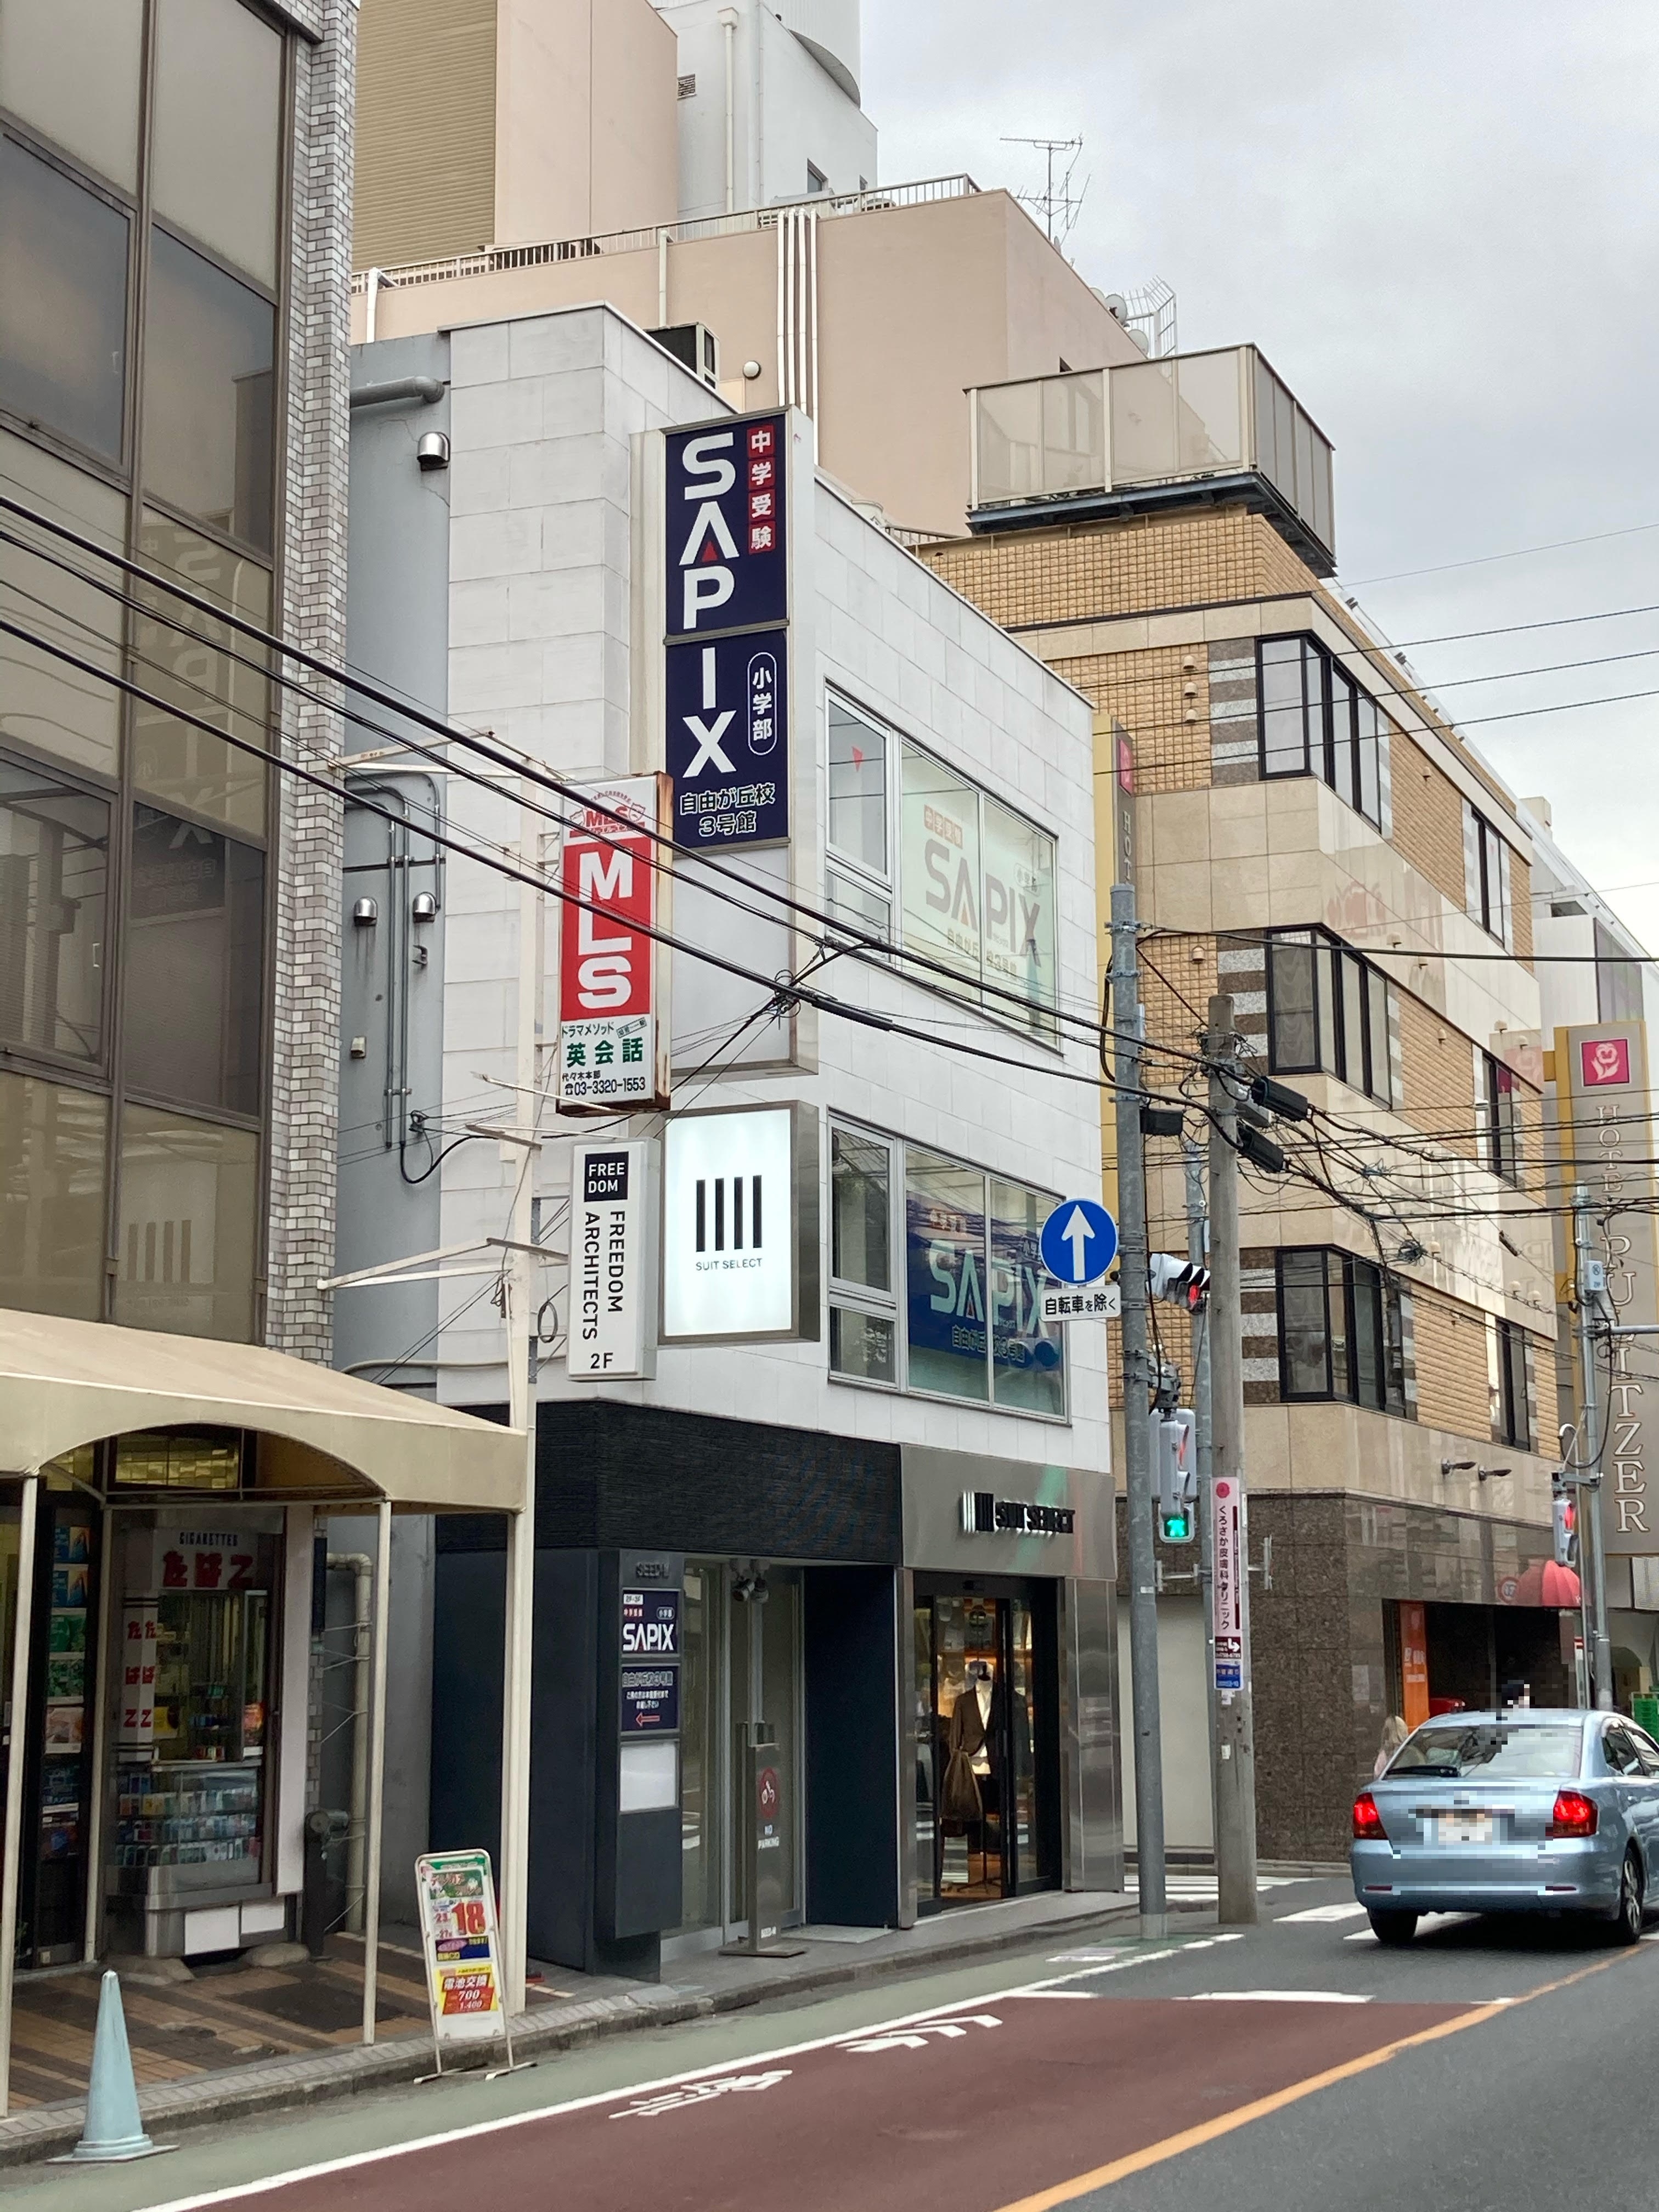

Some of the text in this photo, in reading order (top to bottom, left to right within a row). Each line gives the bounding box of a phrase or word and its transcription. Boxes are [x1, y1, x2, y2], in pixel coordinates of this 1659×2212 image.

[749, 429, 772, 550] 中学受験
[679, 431, 740, 778] SAPIX
[752, 667, 773, 741] 小学部
[680, 783, 776, 815] 自由が丘校
[699, 811, 757, 837] 3号館
[925, 838, 1041, 968] SAPIX
[578, 850, 634, 1009] MLS
[562, 1022, 614, 1039] ドラマメソッド
[567, 1037, 644, 1068] 英会話
[562, 1070, 601, 1082] 代々木本部
[574, 1077, 646, 1096] 03-3320-1553
[589, 1162, 625, 1177] FREE
[588, 1180, 618, 1193] DOM
[582, 1211, 601, 1340] ARCHITECTS
[607, 1211, 625, 1312] FREEDOM
[696, 1258, 762, 1271] SUIT SELECT
[1045, 1294, 1116, 1315] 自転車を除く
[590, 1353, 613, 1369] 2F
[623, 1623, 674, 1651] SAPIX
